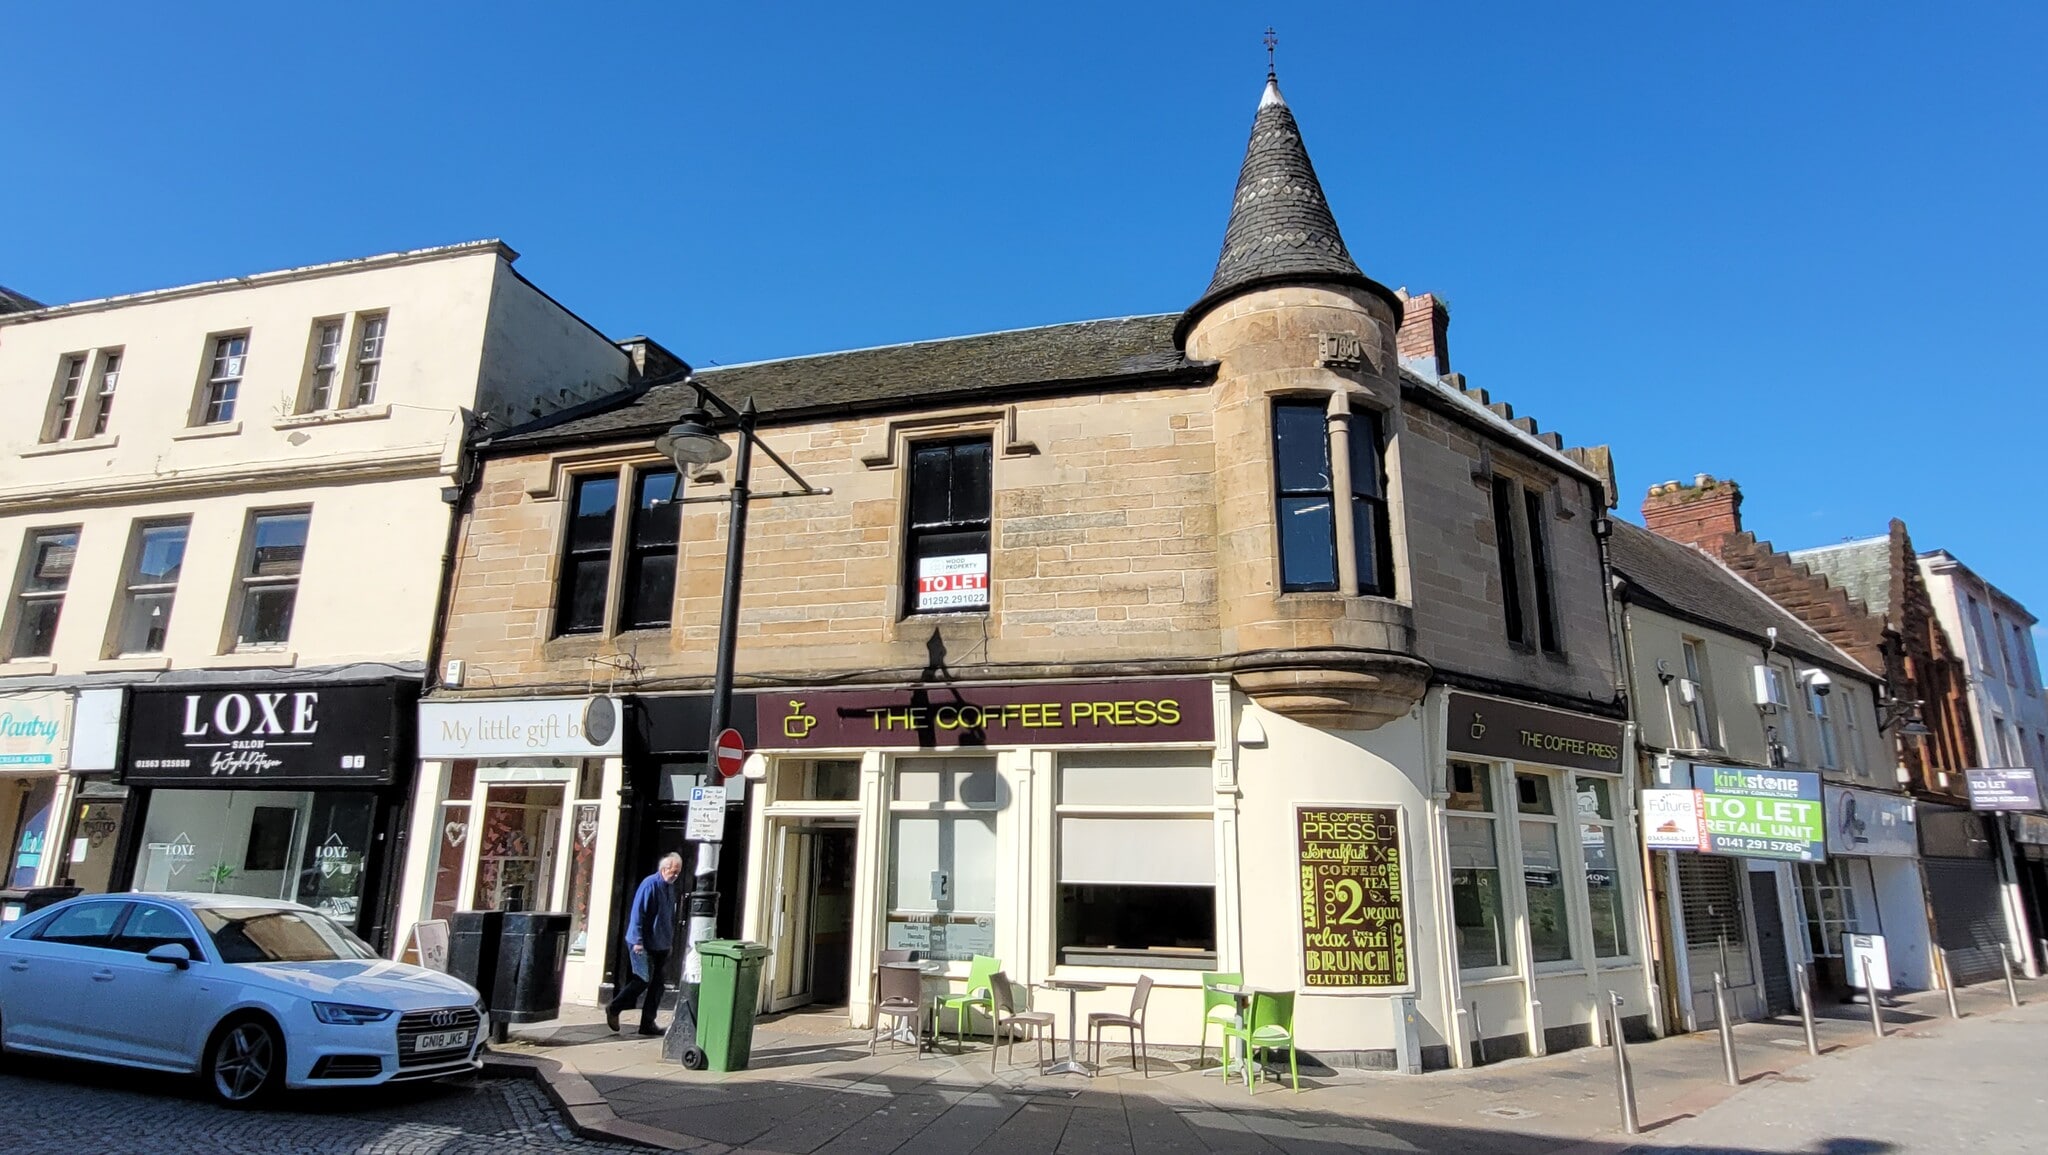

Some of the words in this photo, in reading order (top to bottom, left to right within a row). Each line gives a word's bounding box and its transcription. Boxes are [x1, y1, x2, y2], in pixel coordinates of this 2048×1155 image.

[922, 576, 948, 592] TO
[952, 574, 985, 590] LET
[922, 596, 949, 606] 01292
[951, 593, 985, 604] 291022
[181, 692, 319, 736] LOXE
[866, 707, 929, 731] THE
[936, 703, 1063, 729] COFFEE
[1070, 699, 1182, 727] PRESS
[0, 712, 60, 745] Pantry
[442, 720, 473, 748] My
[478, 714, 521, 740] little
[526, 713, 561, 747] gift
[231, 739, 265, 749] SALON
[1520, 730, 1543, 748] THE
[1543, 734, 1585, 755] COFFEE
[1587, 742, 1619, 760] PRESS
[1713, 768, 1799, 792] kirkstone
[1971, 781, 1987, 789] TO
[1988, 780, 2006, 788] LET
[1649, 799, 1691, 812] Future
[1705, 797, 1746, 819] TO
[1755, 800, 1812, 824] LET
[1302, 812, 1328, 822] THE
[1329, 812, 1375, 823] COFFEE
[1302, 822, 1377, 840] PRESS
[1706, 819, 1767, 835] RETAIL
[1771, 824, 1814, 839] UNIT
[165, 844, 196, 856] LOXE
[315, 846, 350, 858] LOXE
[1301, 843, 1370, 864] Breakfast
[1716, 837, 1743, 847] 0141
[1746, 839, 1768, 849] 291
[1770, 841, 1802, 852] 5786
[1319, 864, 1379, 876] COFFEE
[1387, 848, 1401, 903] organic
[1362, 877, 1389, 889] TEA
[1301, 865, 1317, 928] LUNCH
[1323, 878, 1337, 925] FOOD
[1334, 878, 1364, 925] 2
[1363, 906, 1402, 927] vegan
[1306, 926, 1350, 948] relax
[1353, 931, 1389, 948] wifi
[1305, 950, 1390, 972] BRUNCH
[1392, 922, 1406, 983] CAKES
[1306, 974, 1358, 985] GLUTEN
[1361, 974, 1392, 985] FREE
[422, 1034, 445, 1048] GN18
[446, 1031, 464, 1046] JKE
